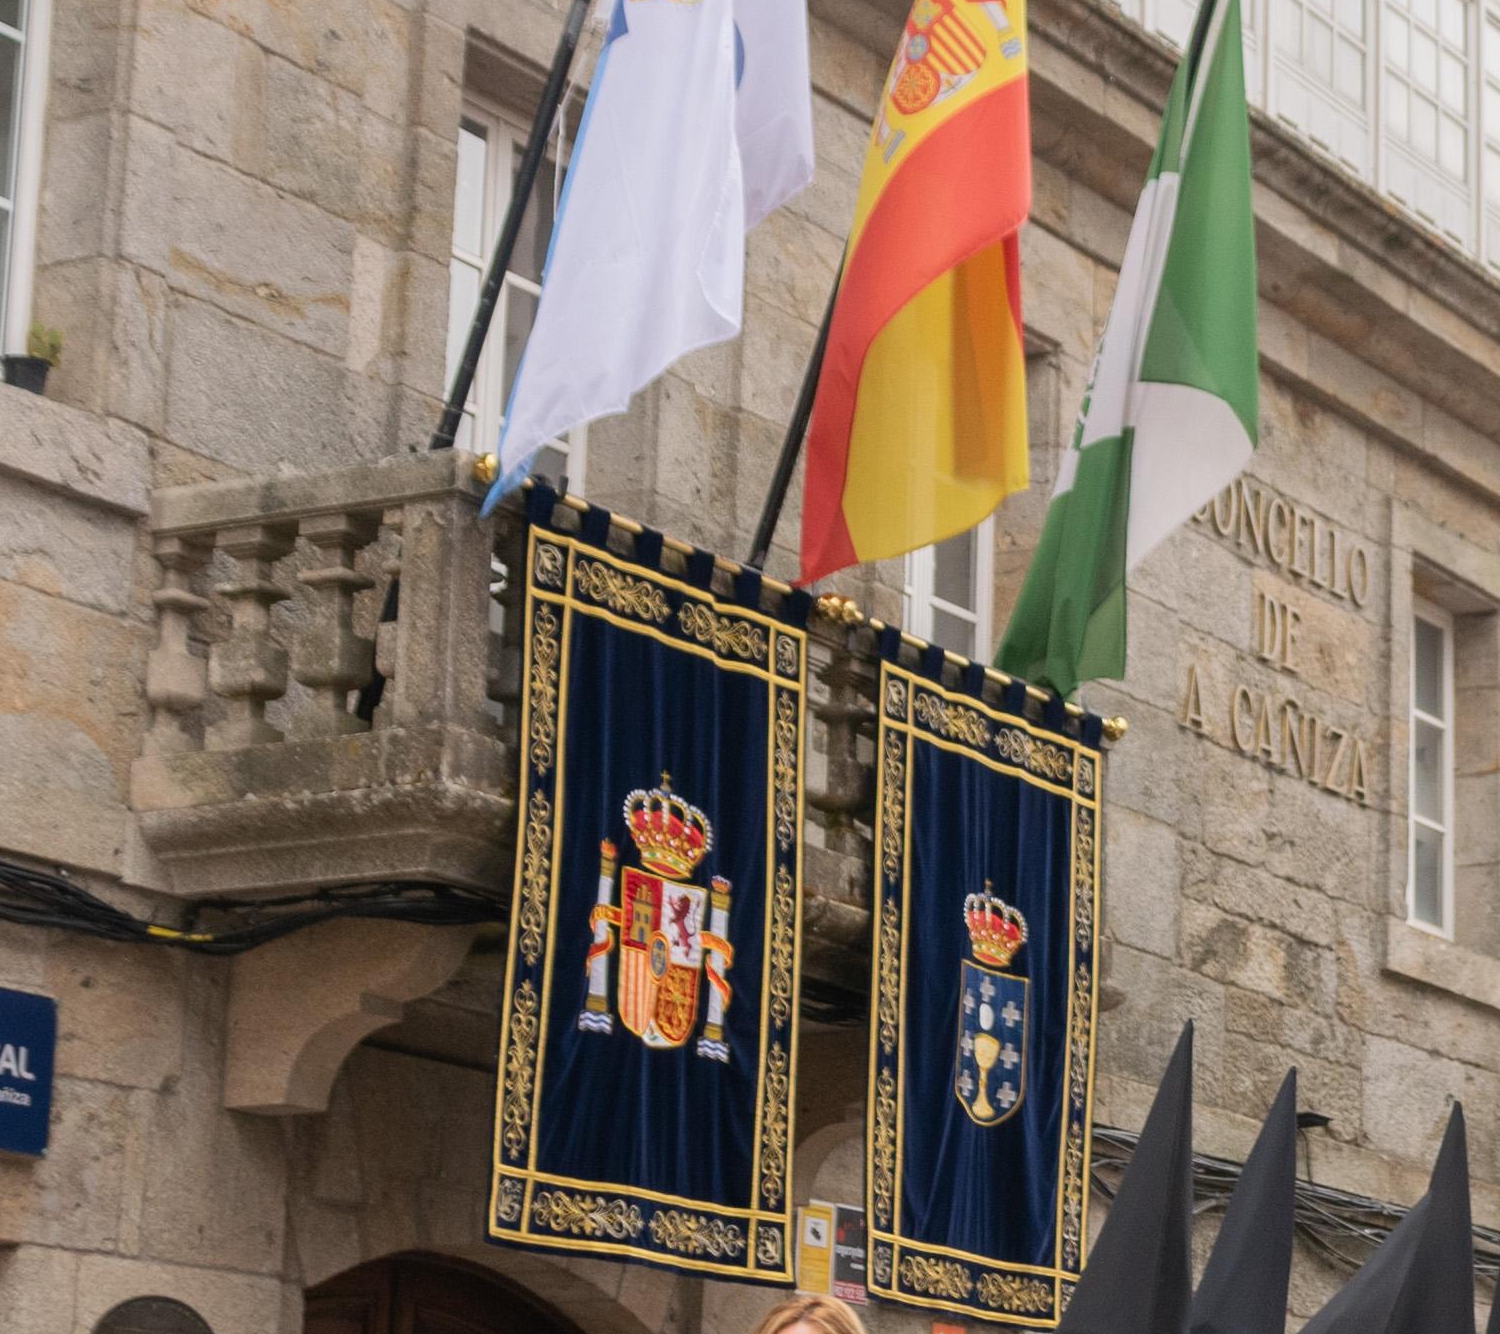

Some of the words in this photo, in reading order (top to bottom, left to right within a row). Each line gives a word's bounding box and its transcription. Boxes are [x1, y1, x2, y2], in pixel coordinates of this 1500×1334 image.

[1192, 477, 1368, 607] ONCELLO
[1258, 593, 1300, 673] DE
[1181, 664, 1203, 733] A
[1230, 683, 1368, 805] CAÑIZA
